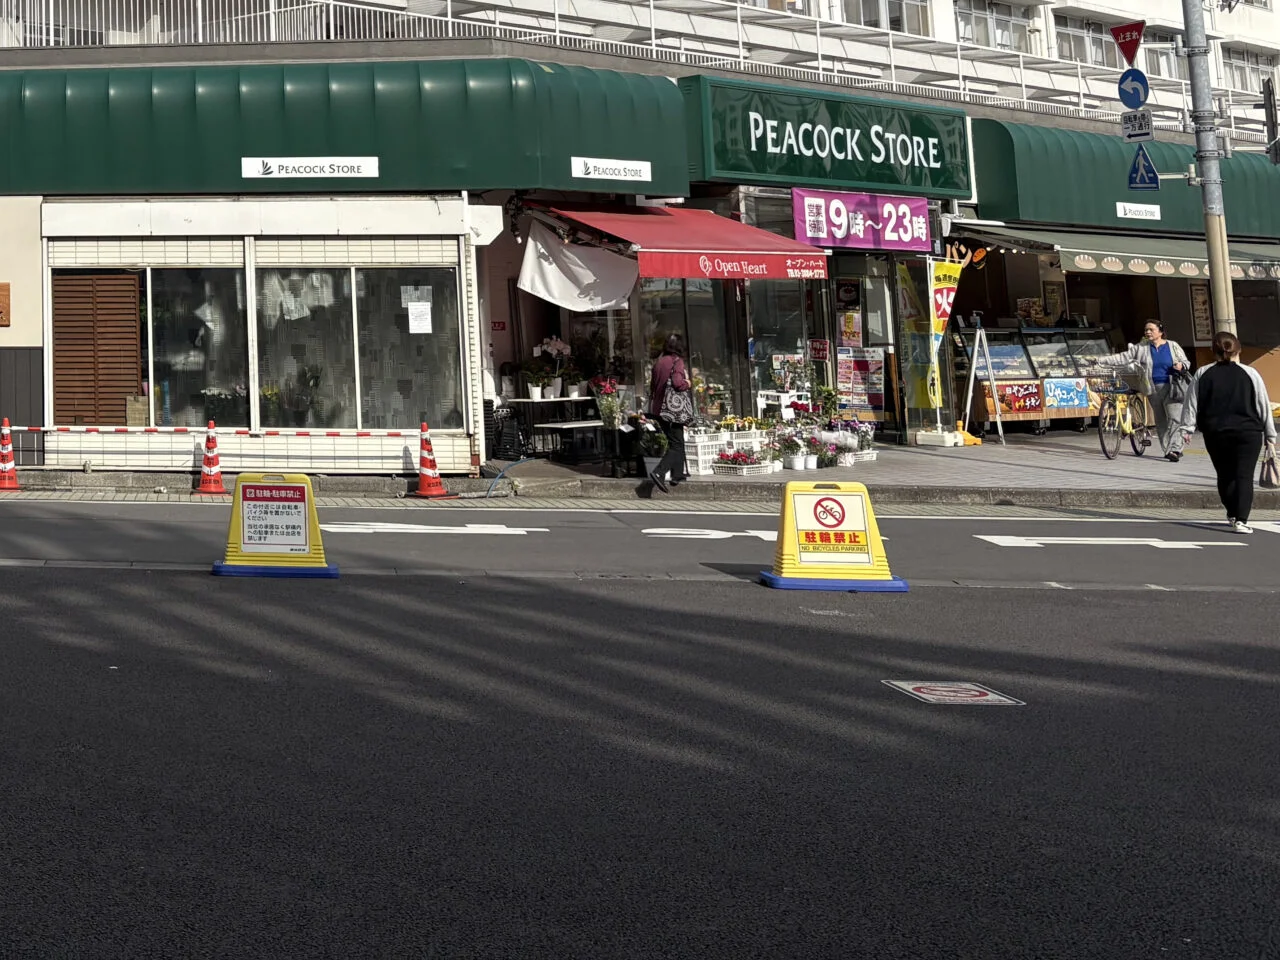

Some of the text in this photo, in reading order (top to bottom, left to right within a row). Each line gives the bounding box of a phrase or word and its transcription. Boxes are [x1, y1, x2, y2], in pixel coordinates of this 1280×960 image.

[1118, 30, 1140, 43] 止まれ
[1123, 121, 1150, 132] 一方通行
[748, 111, 942, 169] PEACOCK STORE
[278, 163, 363, 174] PEACOCK STORE
[593, 165, 642, 178] PEACOCK STORE
[945, 241, 973, 269] パン
[714, 258, 768, 276] Open Heart
[936, 289, 956, 316] 火
[805, 532, 861, 544] 駐輪禁止
